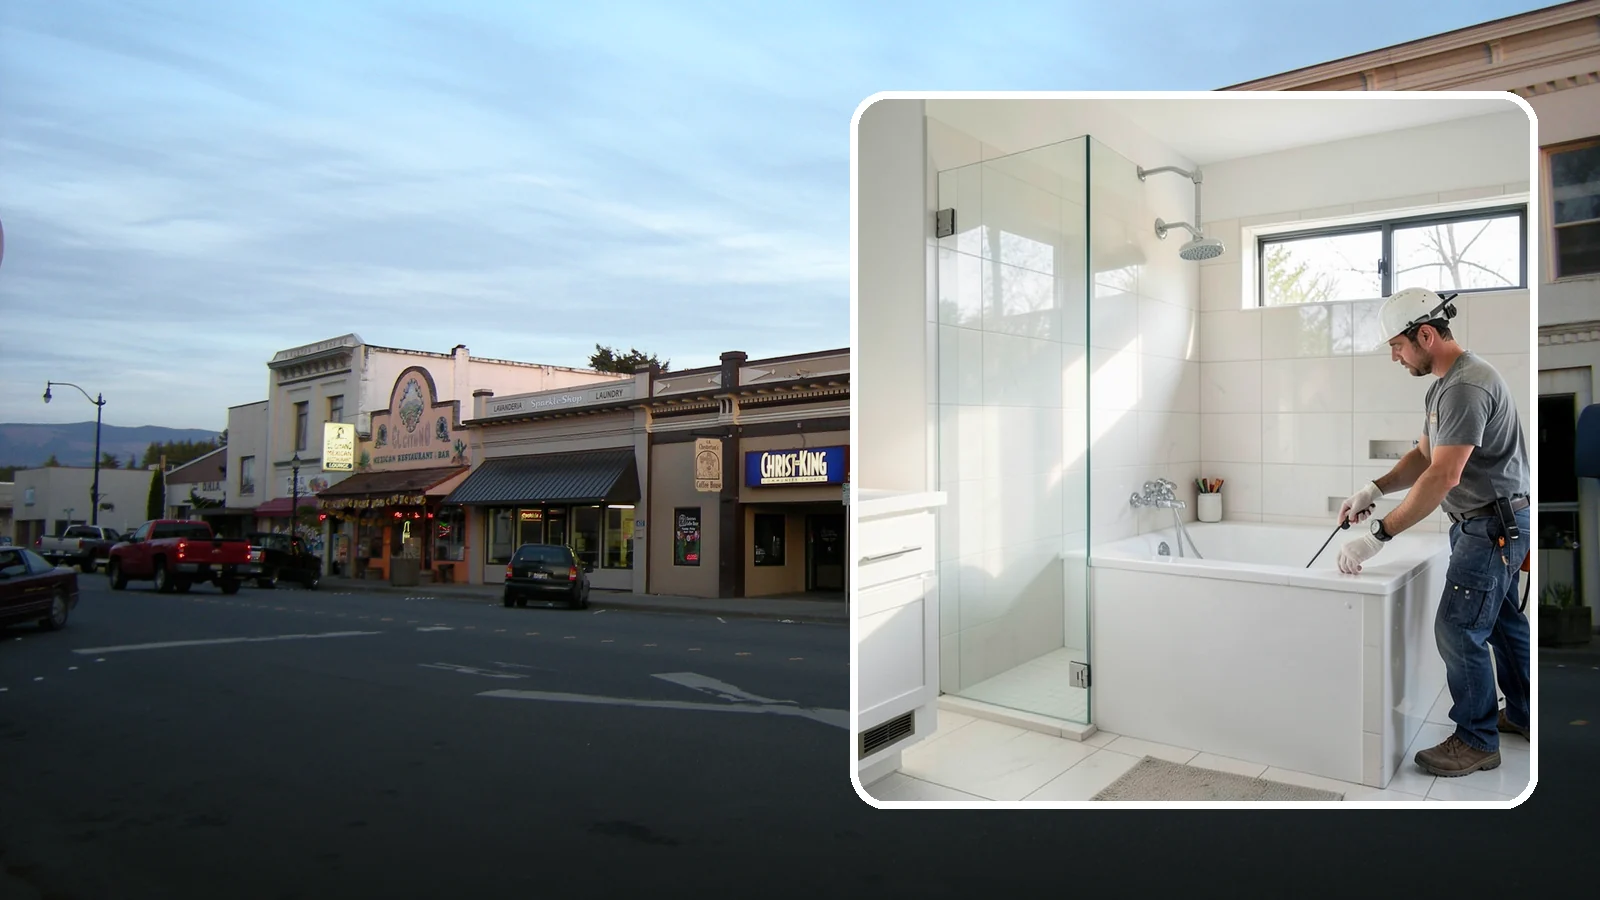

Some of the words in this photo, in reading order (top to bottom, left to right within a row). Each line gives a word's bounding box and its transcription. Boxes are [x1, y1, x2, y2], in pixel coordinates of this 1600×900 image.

[595, 389, 623, 399] LAUNDRY
[494, 402, 523, 412] LAVANDERIA
[530, 396, 561, 409] Sparkle
[561, 394, 583, 404] Shop
[373, 455, 396, 464] MEXICAN
[398, 451, 434, 462] RESTAURANT
[438, 450, 450, 459] BAR
[761, 452, 797, 478] CHRIST
[797, 449, 827, 476] KING
